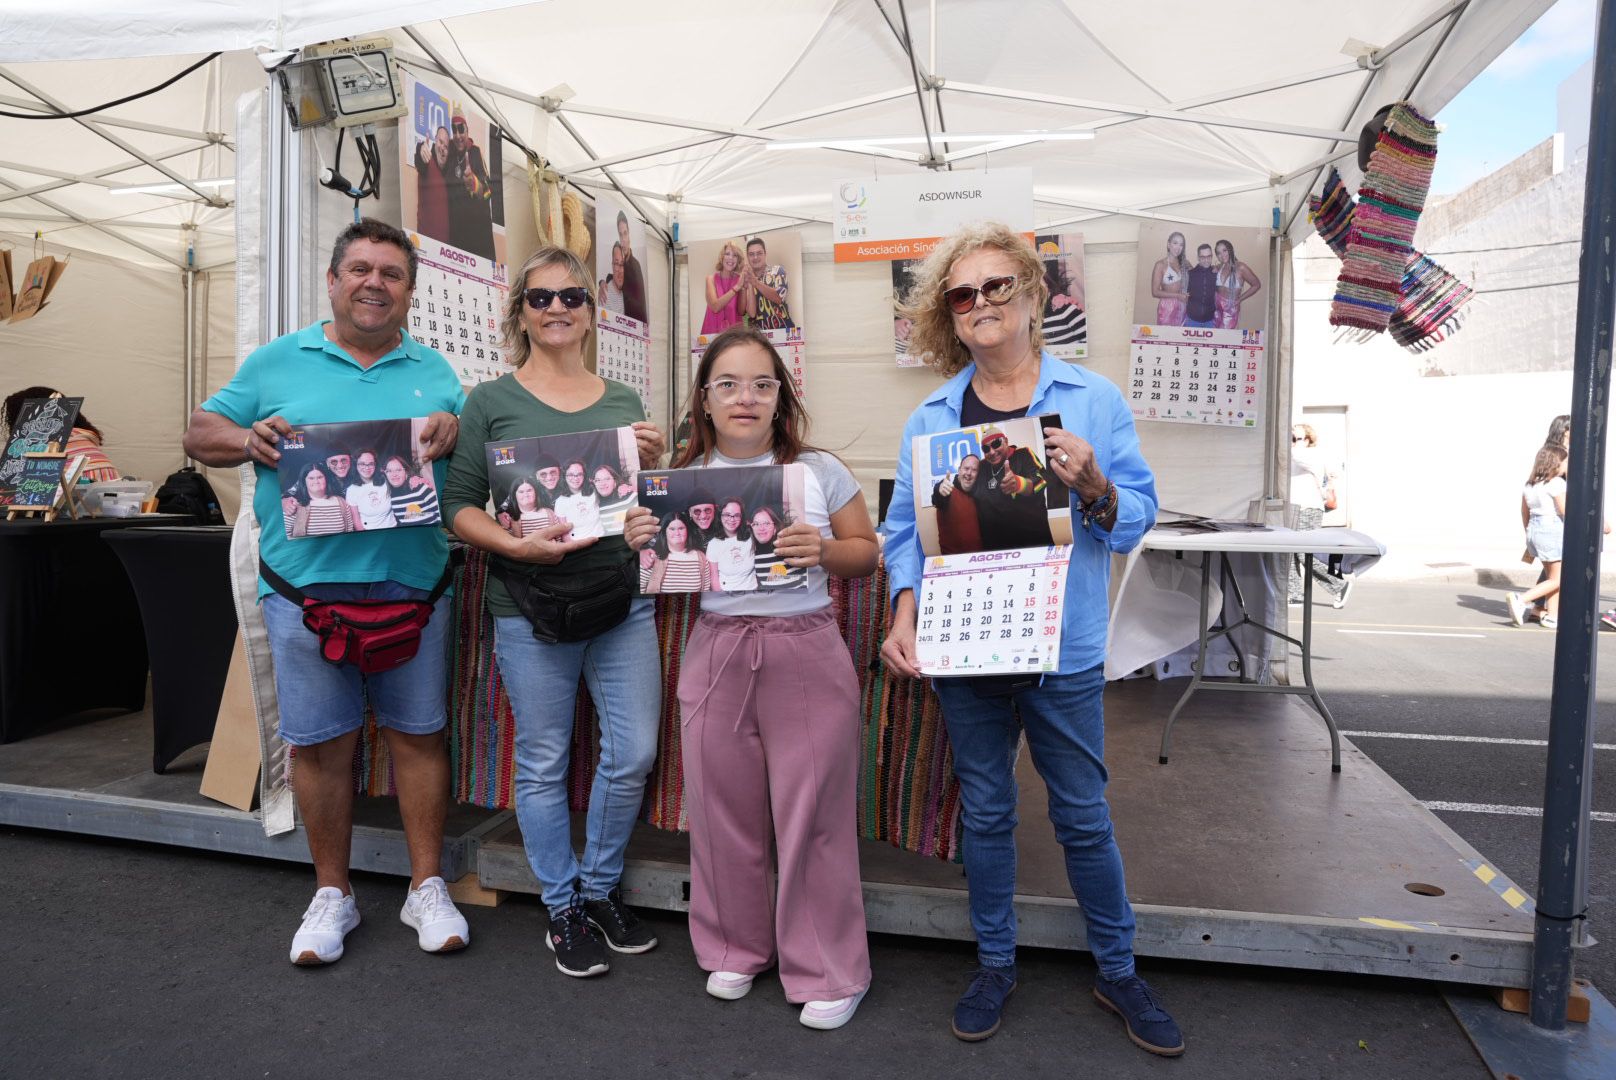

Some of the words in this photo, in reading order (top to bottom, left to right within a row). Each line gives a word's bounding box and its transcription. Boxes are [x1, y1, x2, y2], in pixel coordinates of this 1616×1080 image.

[919, 190, 982, 202] ASDOWNSUR
[440, 247, 476, 267] AGOSTO
[857, 244, 909, 255] Asociación
[428, 285, 432, 295] 4
[444, 290, 448, 299] 5
[459, 294, 463, 304] 6
[473, 299, 478, 307] 7
[488, 303, 492, 311] 8
[486, 287, 490, 295] 1
[500, 291, 504, 299] 2
[412, 298, 420, 309] 10
[428, 303, 435, 313] 11
[443, 307, 451, 317] 12
[458, 311, 466, 321] 13
[473, 315, 480, 325] 14
[487, 318, 494, 329] 15
[616, 315, 637, 329] OCTUBRE
[413, 316, 420, 327] 17
[429, 320, 437, 331] 18
[445, 325, 452, 334] 19
[460, 328, 468, 338] 20
[475, 333, 482, 342] 21
[430, 338, 439, 349] 25
[446, 342, 455, 352] 26
[461, 345, 469, 355] 27
[476, 349, 484, 358] 28
[491, 351, 498, 361] 29
[969, 552, 1021, 563] AGOSTO
[1053, 567, 1059, 575] 2
[928, 592, 933, 600] 3
[947, 591, 952, 599] 4
[967, 589, 971, 597] 5
[987, 587, 991, 595] 6
[1008, 585, 1013, 593] 7
[1029, 583, 1034, 591] 8
[1052, 581, 1057, 589] 9
[924, 607, 933, 615] 10
[944, 605, 952, 613] 11
[963, 603, 972, 612] 12
[983, 602, 992, 610] 13
[1003, 599, 1013, 608] 14
[1025, 598, 1035, 606] 15
[1047, 596, 1058, 605] 16
[923, 620, 932, 629] 17
[942, 619, 951, 627] 18
[961, 617, 971, 626] 19
[981, 616, 991, 625] 20
[1002, 614, 1011, 623] 21
[1023, 613, 1034, 622] 22
[1045, 611, 1057, 620] 23
[940, 634, 950, 642] 25
[960, 632, 970, 640] 26
[980, 631, 990, 639] 27
[1001, 630, 1011, 638] 28
[1022, 628, 1033, 637] 29
[1044, 626, 1055, 635] 30
